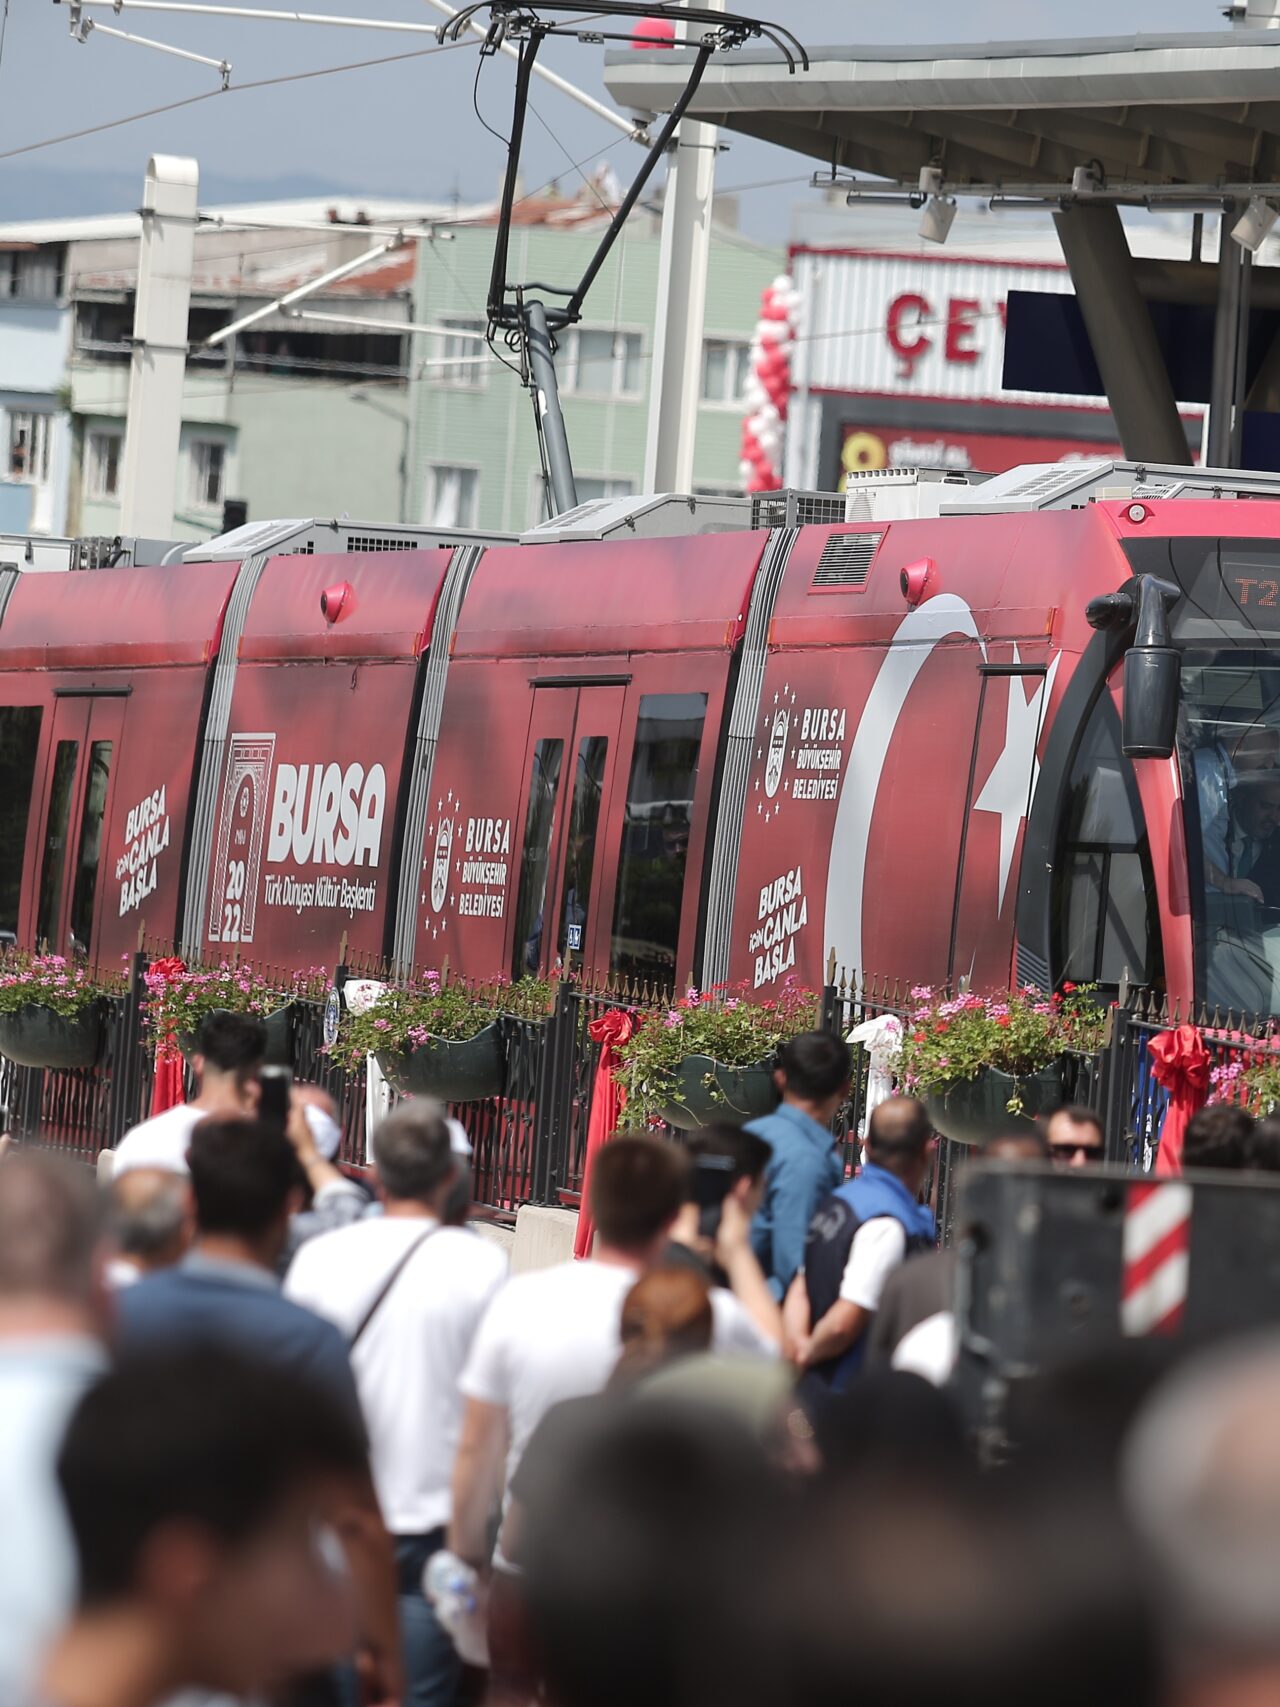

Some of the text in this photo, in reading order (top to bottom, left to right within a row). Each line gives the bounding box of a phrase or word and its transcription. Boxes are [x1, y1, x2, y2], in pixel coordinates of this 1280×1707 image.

[1234, 577, 1279, 607] T2
[800, 708, 847, 741] BURSA
[796, 743, 842, 770] BÜYÜKŞEHİR
[791, 772, 840, 800] BELEDİYESİ
[125, 784, 166, 845] BURSA
[266, 762, 386, 867] BURSA
[129, 815, 170, 875] CANLA
[465, 818, 511, 854] BURSA
[119, 858, 158, 917] BAŞLA
[226, 860, 245, 900] 20
[461, 856, 508, 886] BÜYÜKŞEHİR
[264, 874, 377, 919] Türk Dünyası Kültür Başkenti
[458, 888, 505, 918] BELEDİYESİ
[758, 865, 802, 921] BURSA
[222, 903, 242, 943] 22
[763, 895, 808, 950] CANLA
[753, 935, 796, 990] BAŞLA
